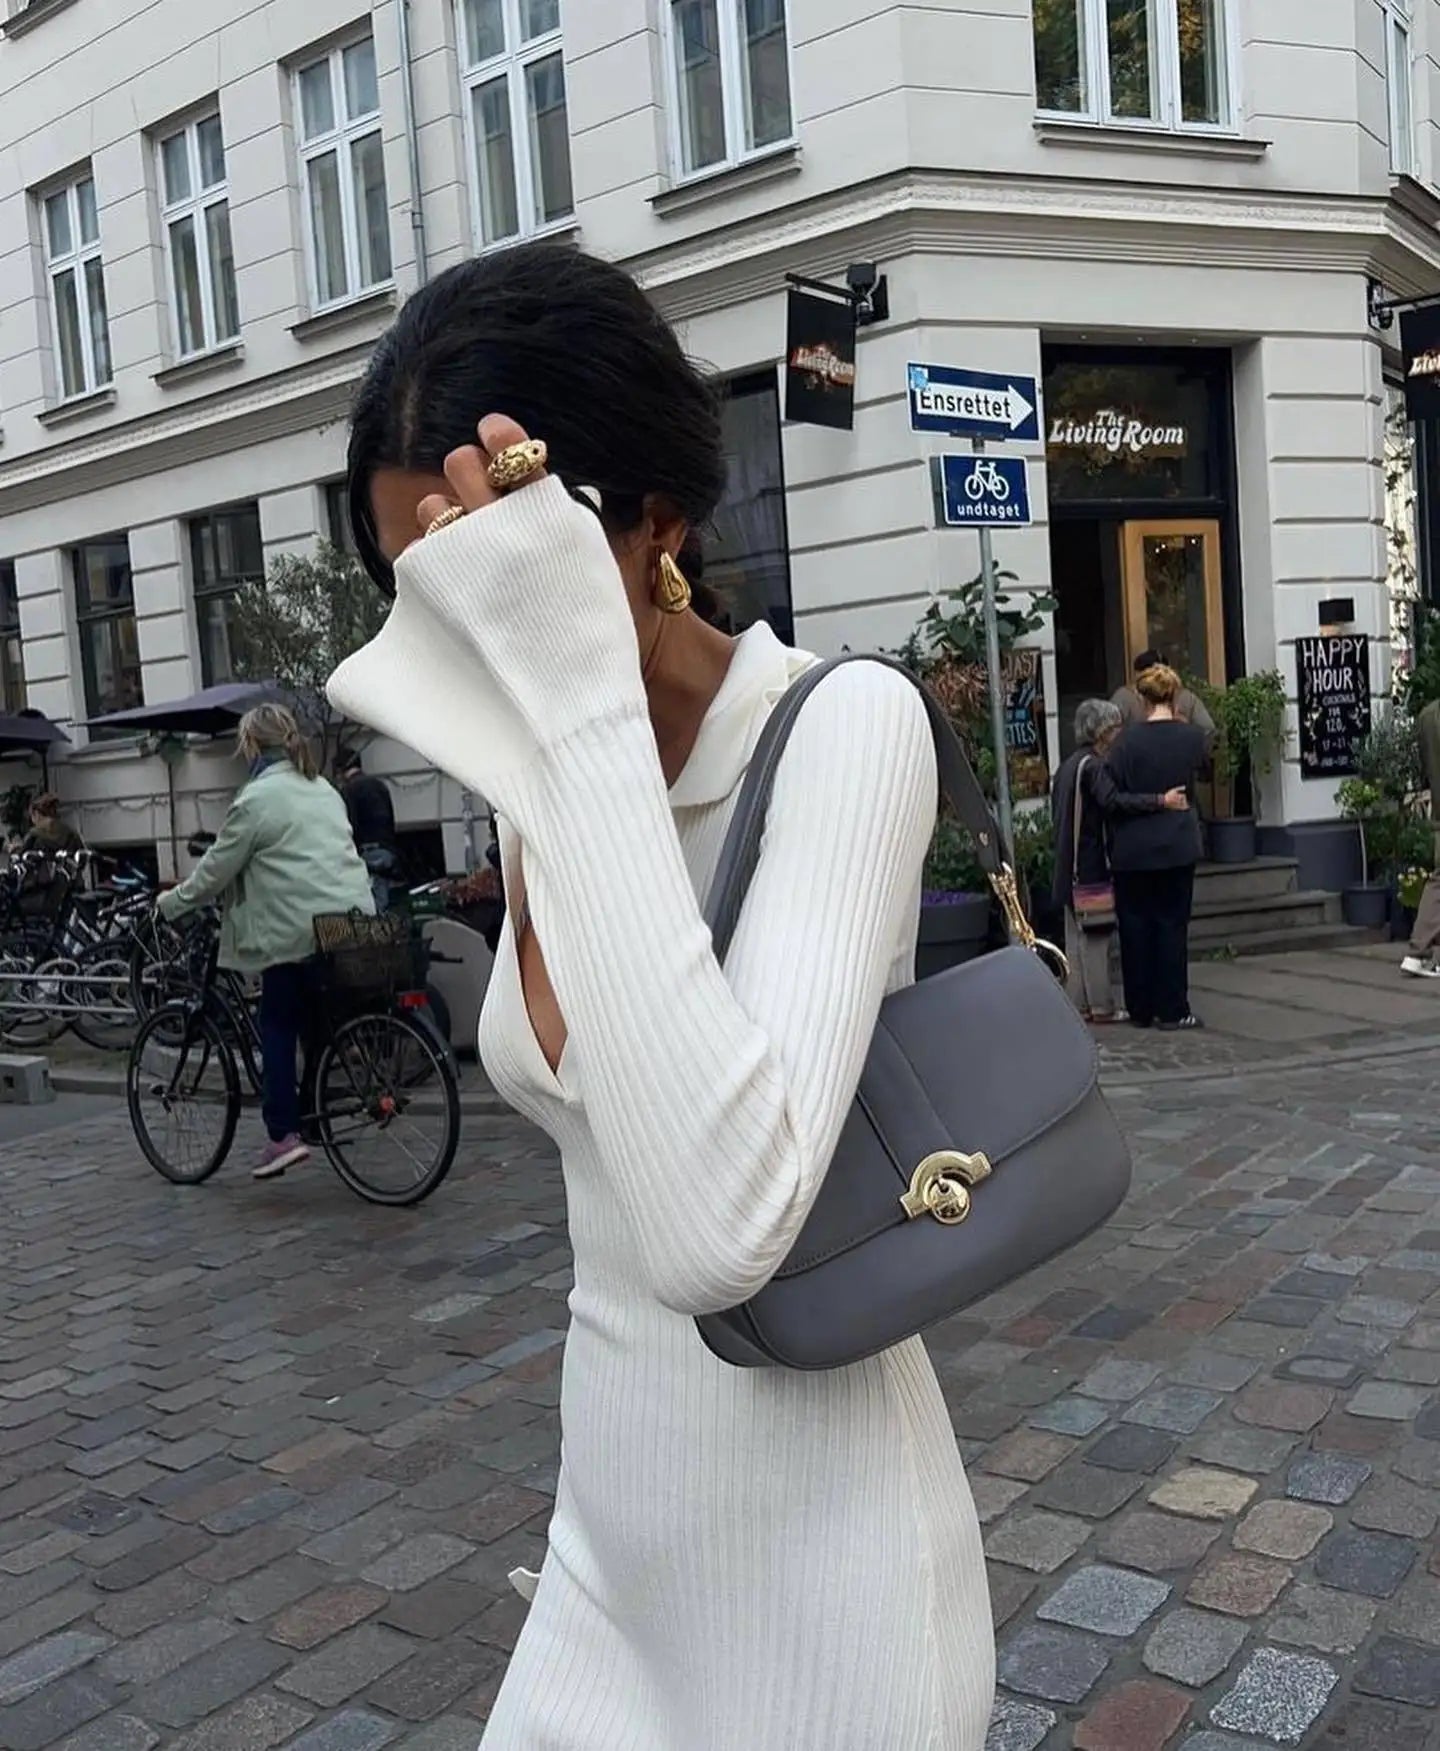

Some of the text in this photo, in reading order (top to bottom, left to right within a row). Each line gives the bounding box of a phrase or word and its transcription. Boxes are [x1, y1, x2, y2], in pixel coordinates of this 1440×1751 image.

[920, 390, 1011, 419] Ensrettet
[1096, 409, 1126, 426] The
[957, 502, 1020, 519] undtaget
[1302, 638, 1364, 668] HAPPY
[1312, 666, 1353, 693] HOUR
